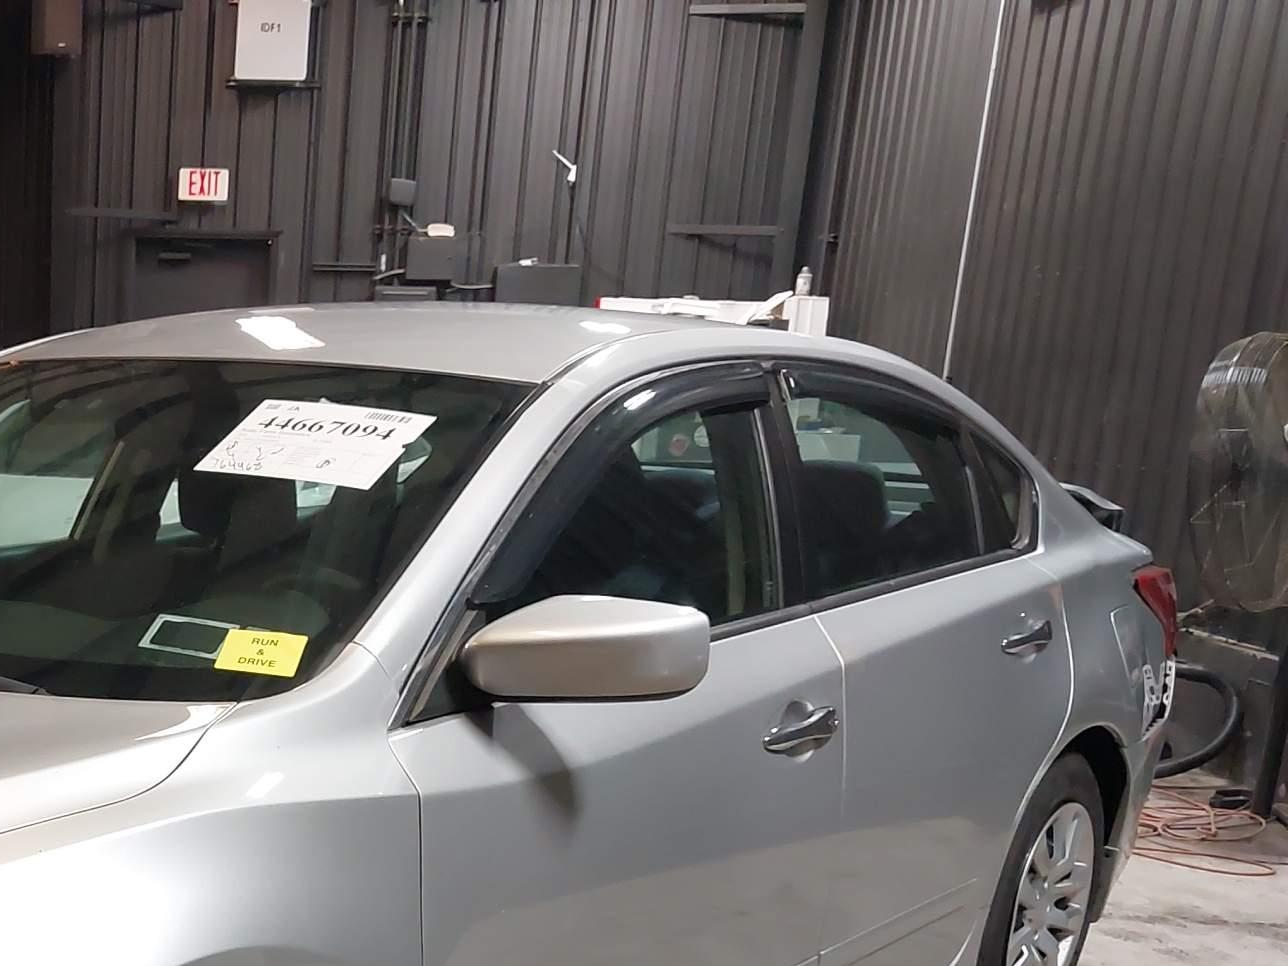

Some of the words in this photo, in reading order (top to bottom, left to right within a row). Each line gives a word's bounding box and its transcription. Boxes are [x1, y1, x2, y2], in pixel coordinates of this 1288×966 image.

[188, 170, 221, 196] EXIT
[258, 415, 397, 440] 44667094
[251, 637, 279, 647] RUN
[256, 648, 264, 656] &
[237, 656, 278, 668] DRIVE
